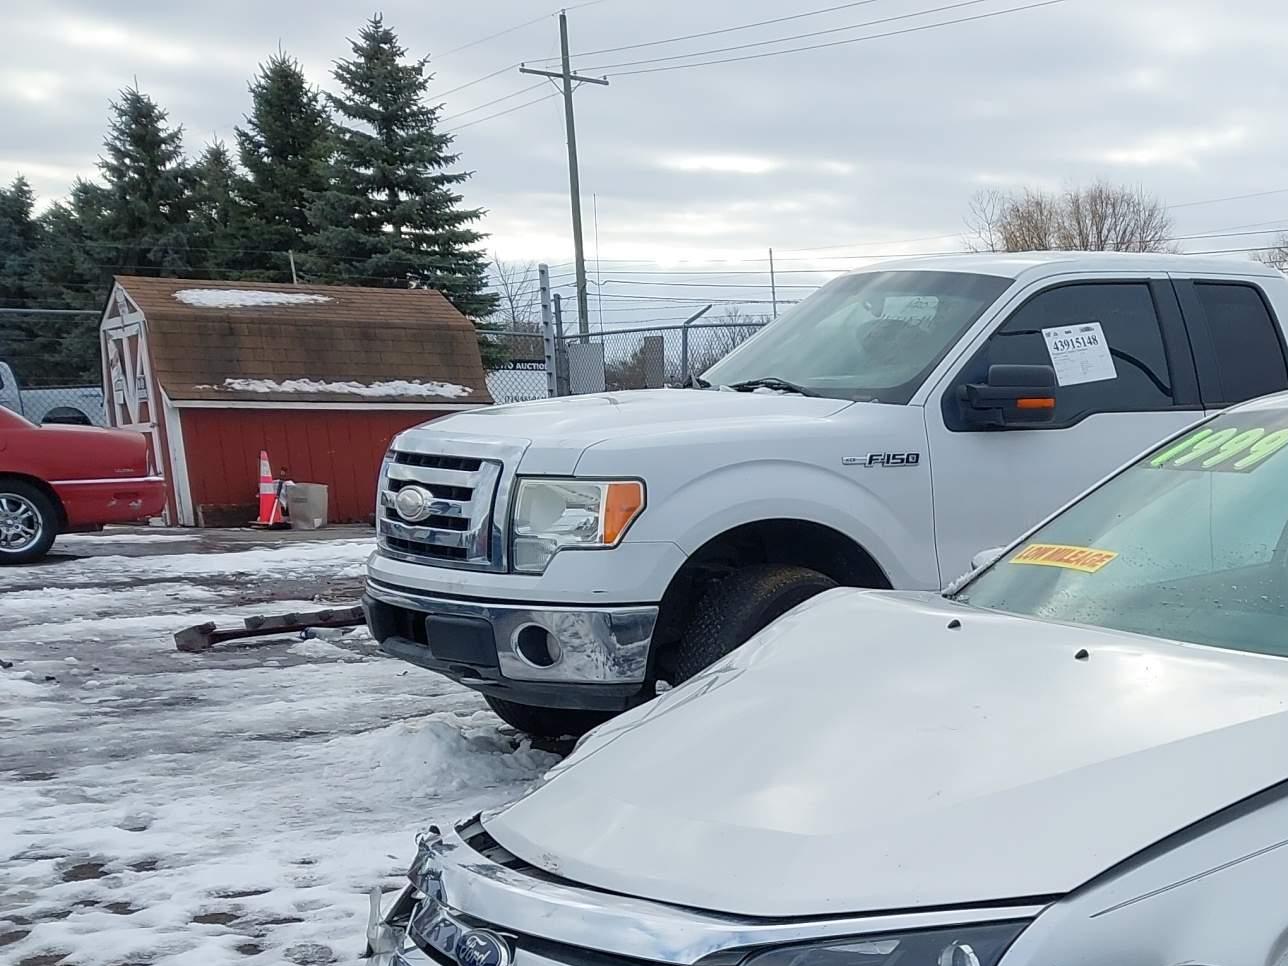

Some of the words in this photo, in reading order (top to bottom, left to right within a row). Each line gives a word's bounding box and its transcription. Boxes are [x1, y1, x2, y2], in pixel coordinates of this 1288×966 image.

[1053, 335, 1099, 352] 43915148
[866, 452, 920, 466] F-150
[460, 935, 492, 966] Ford
